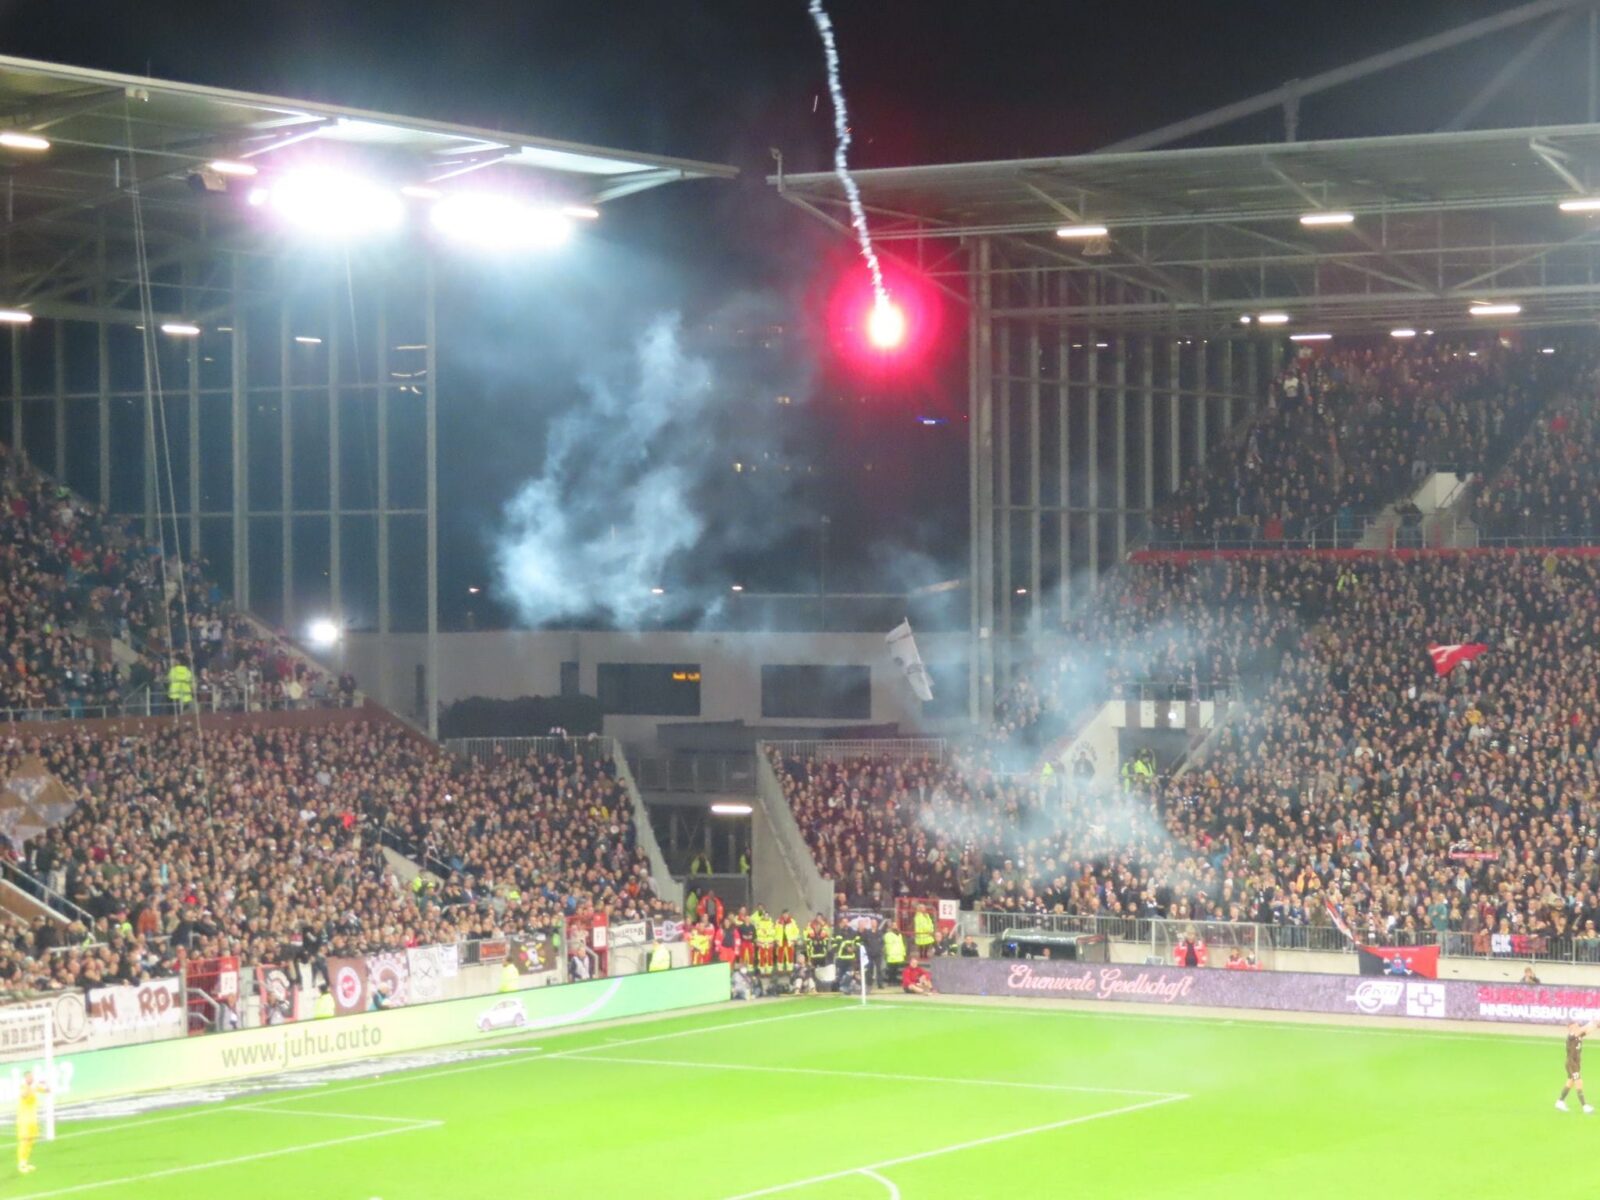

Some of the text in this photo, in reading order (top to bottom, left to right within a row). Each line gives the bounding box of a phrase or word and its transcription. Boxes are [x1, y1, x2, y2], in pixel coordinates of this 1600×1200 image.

[1008, 964, 1193, 1002] Ehrenwerte Gesellschaft
[222, 1024, 381, 1068] www.juhu.auto
